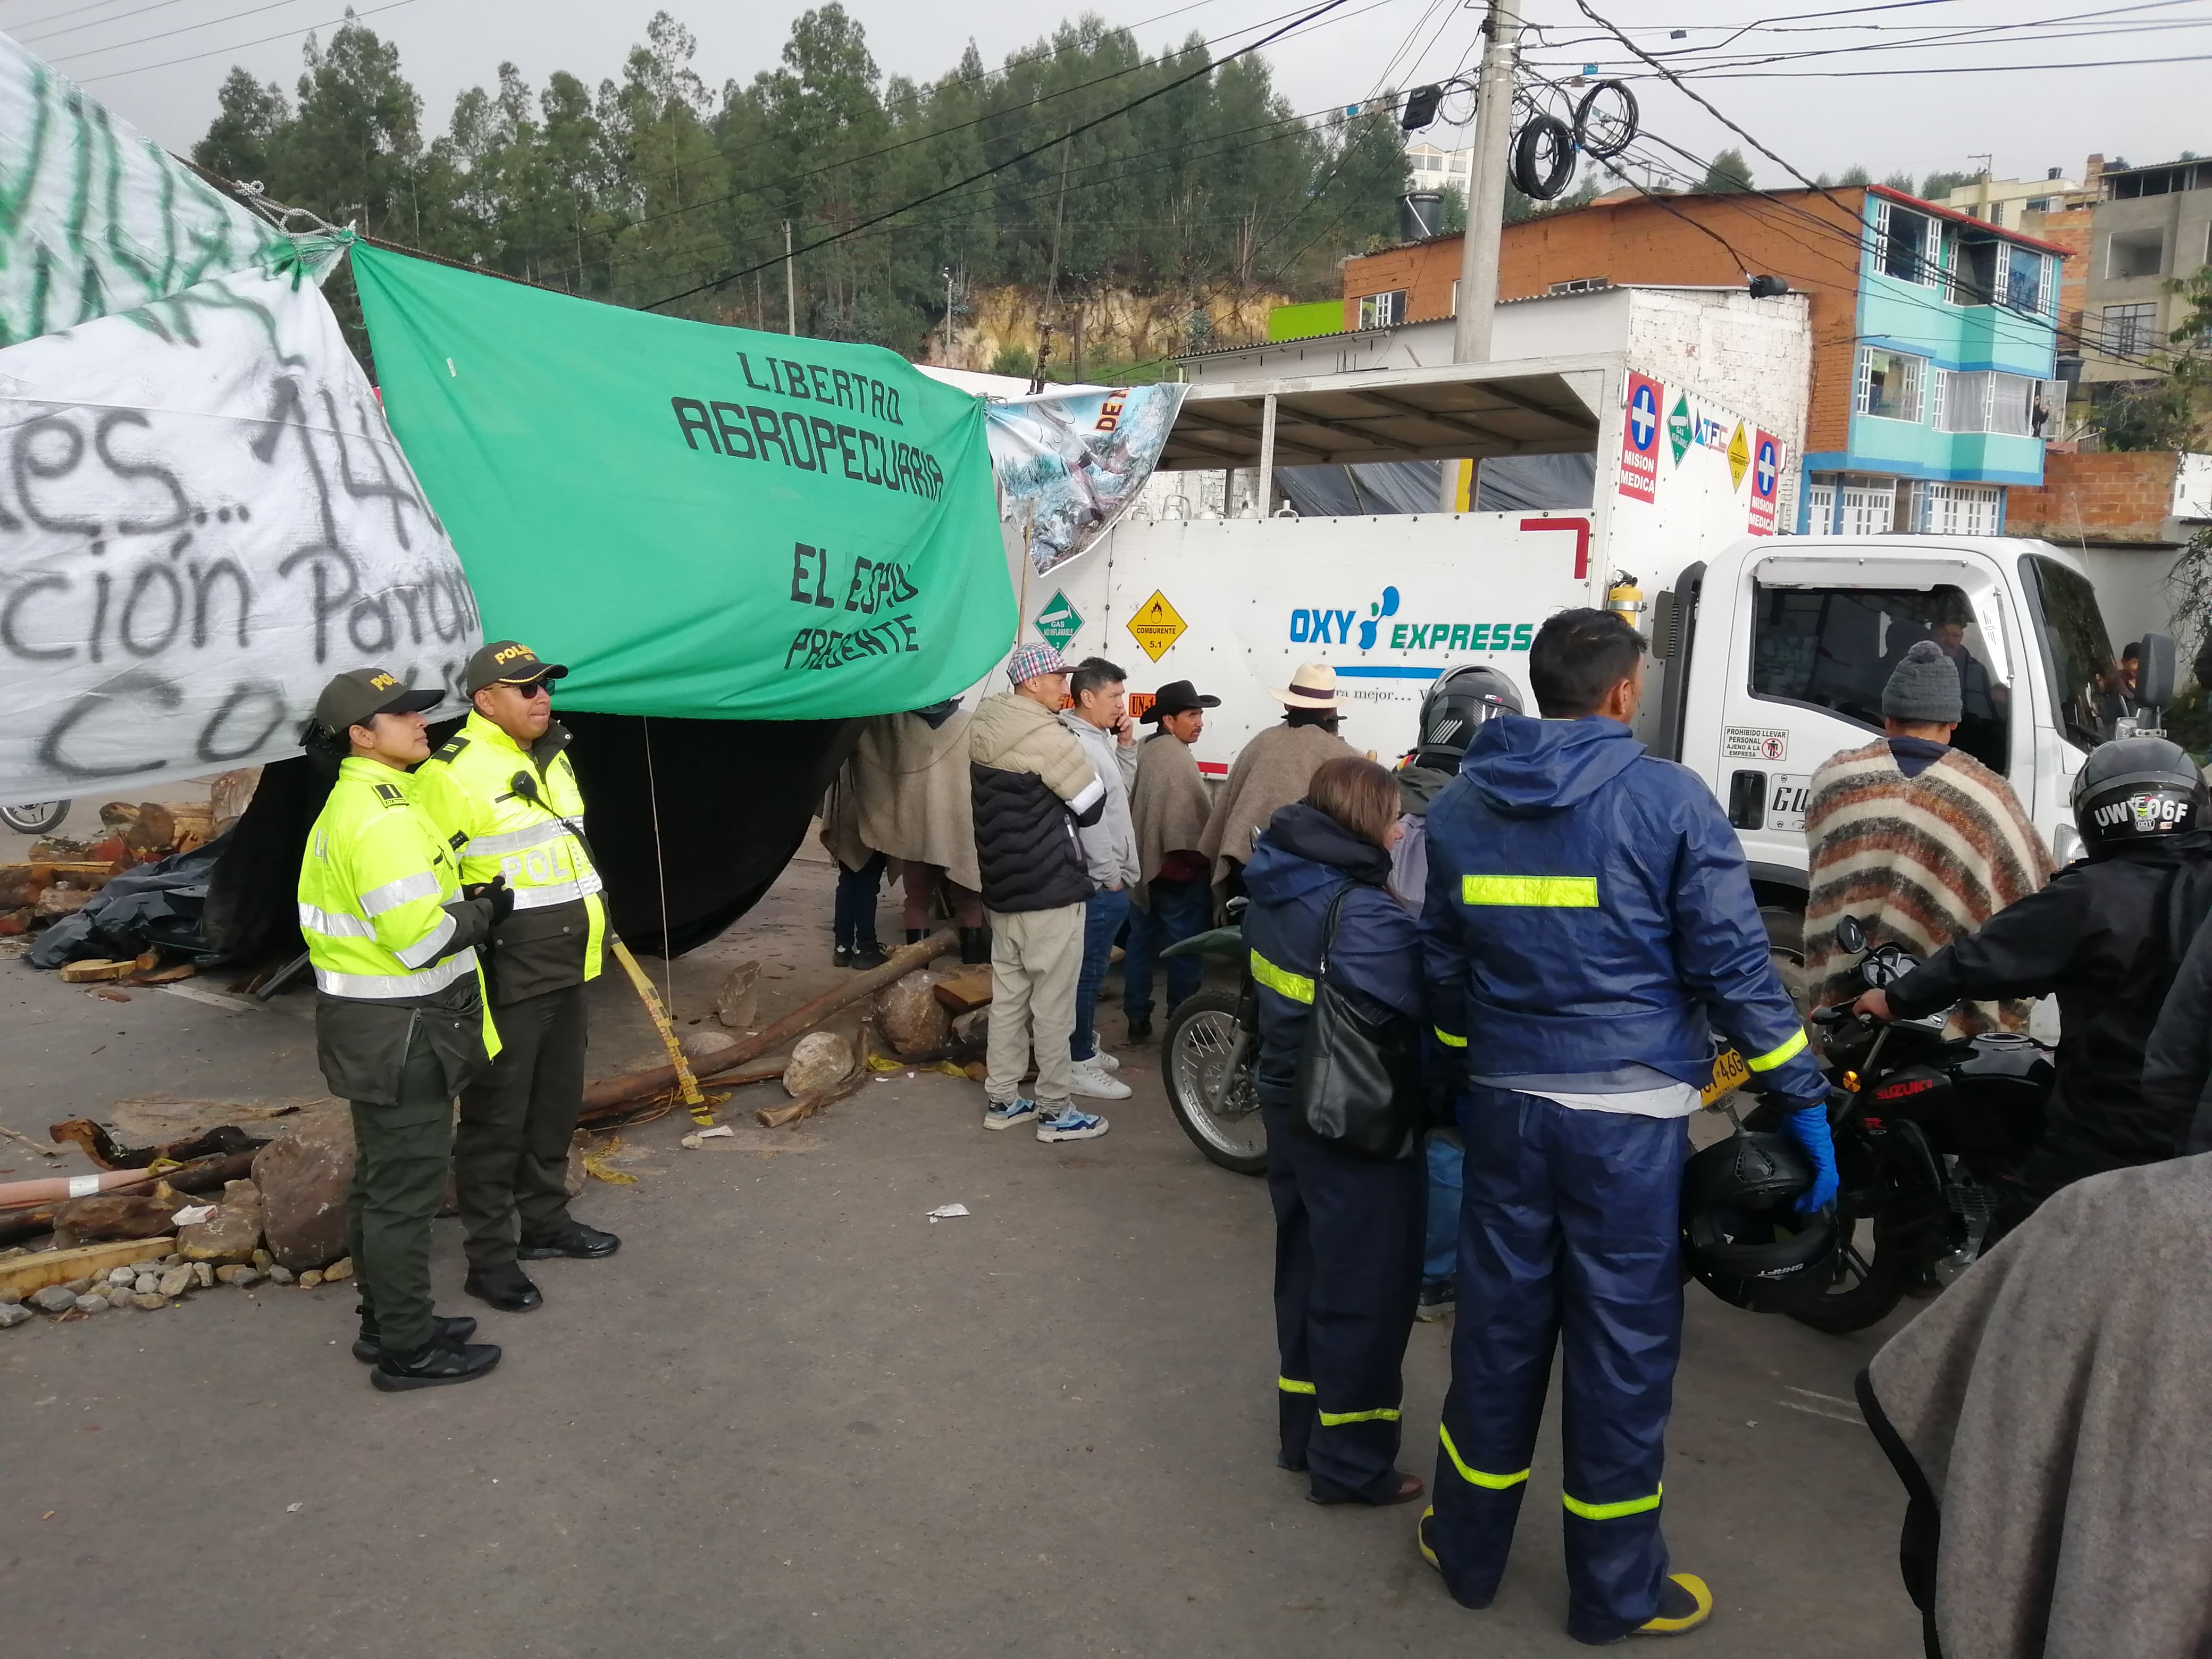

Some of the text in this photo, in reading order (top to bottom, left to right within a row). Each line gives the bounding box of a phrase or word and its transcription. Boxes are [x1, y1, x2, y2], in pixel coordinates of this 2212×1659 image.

[671, 396, 944, 502] AGROPECUARIA
[1624, 449, 1655, 473] MISION
[1620, 469, 1655, 494] MEDICA
[1752, 495, 1774, 515] MISION
[1749, 512, 1774, 532] MEDICA
[790, 542, 834, 608] EL
[1289, 609, 1534, 651] OXY EXPRESS
[1353, 687, 1411, 703] mejor...
[1876, 1079, 1933, 1100] SUZUKI
